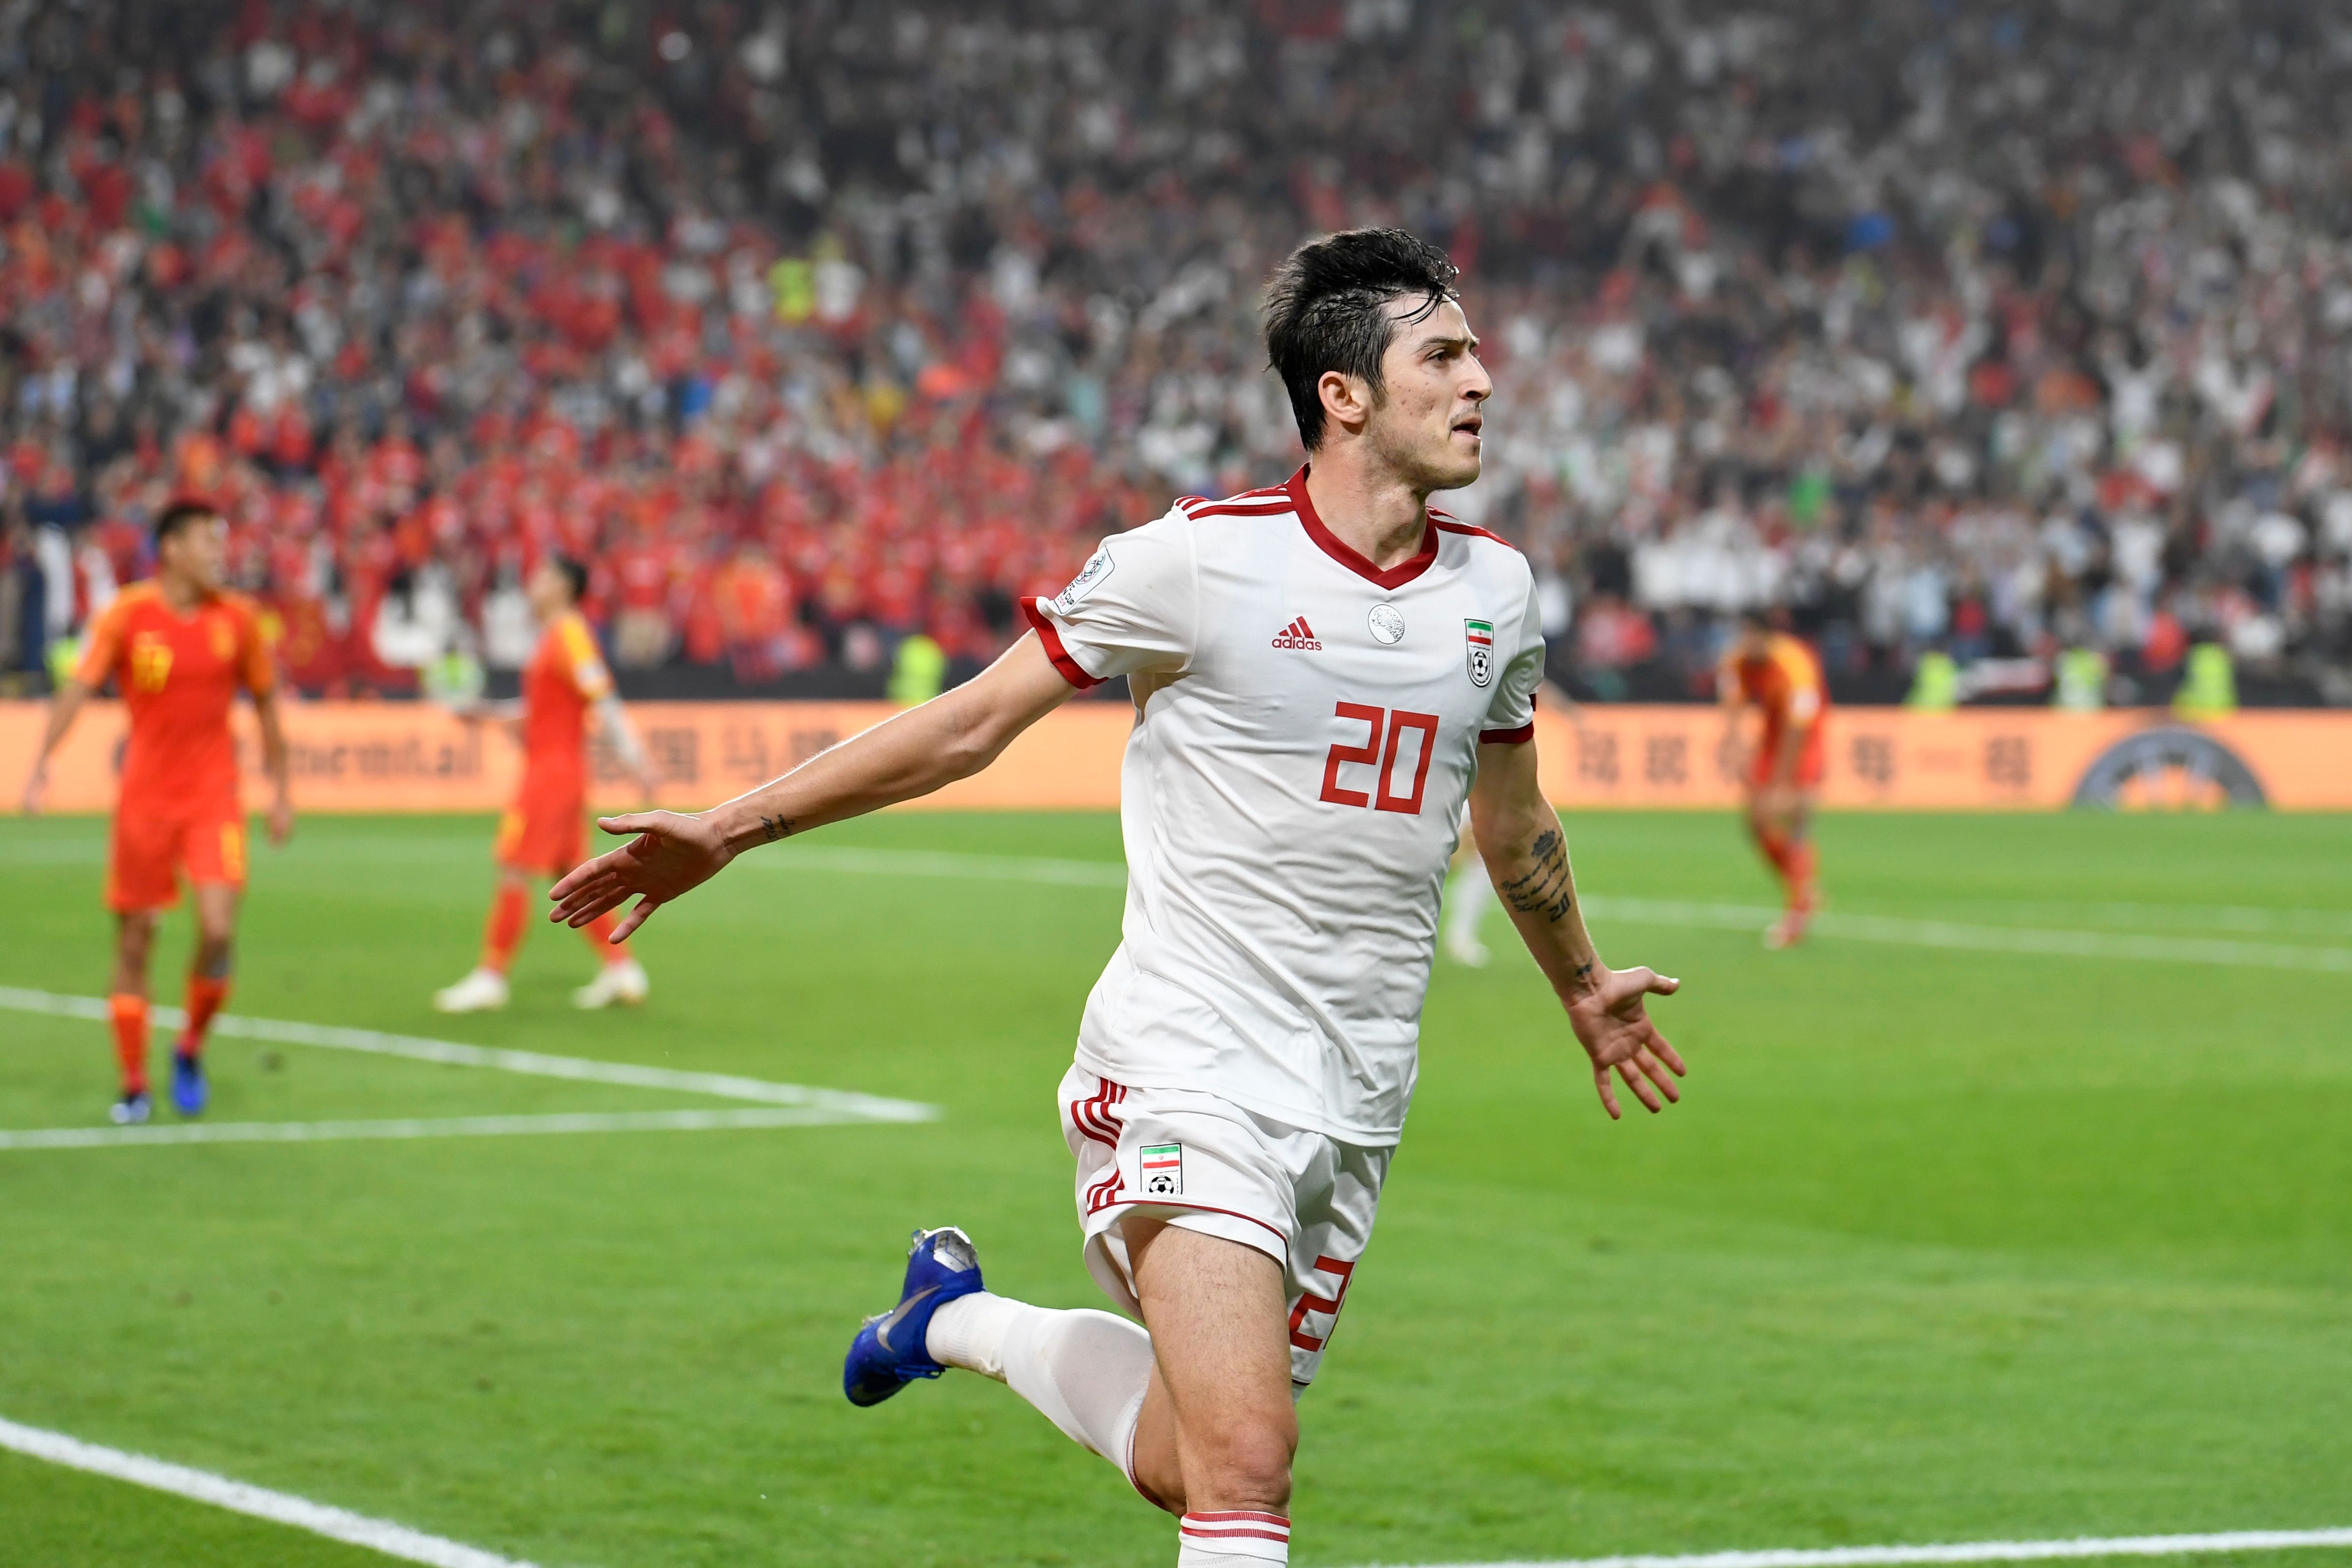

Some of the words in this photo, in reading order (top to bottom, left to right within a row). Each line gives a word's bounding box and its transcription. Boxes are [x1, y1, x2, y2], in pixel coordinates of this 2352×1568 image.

[1065, 593, 1074, 605] CUP
[1272, 636, 1322, 651] adidas
[1319, 701, 1439, 815] 20
[1547, 891, 1571, 923] 20
[1289, 1255, 1355, 1352] 2
